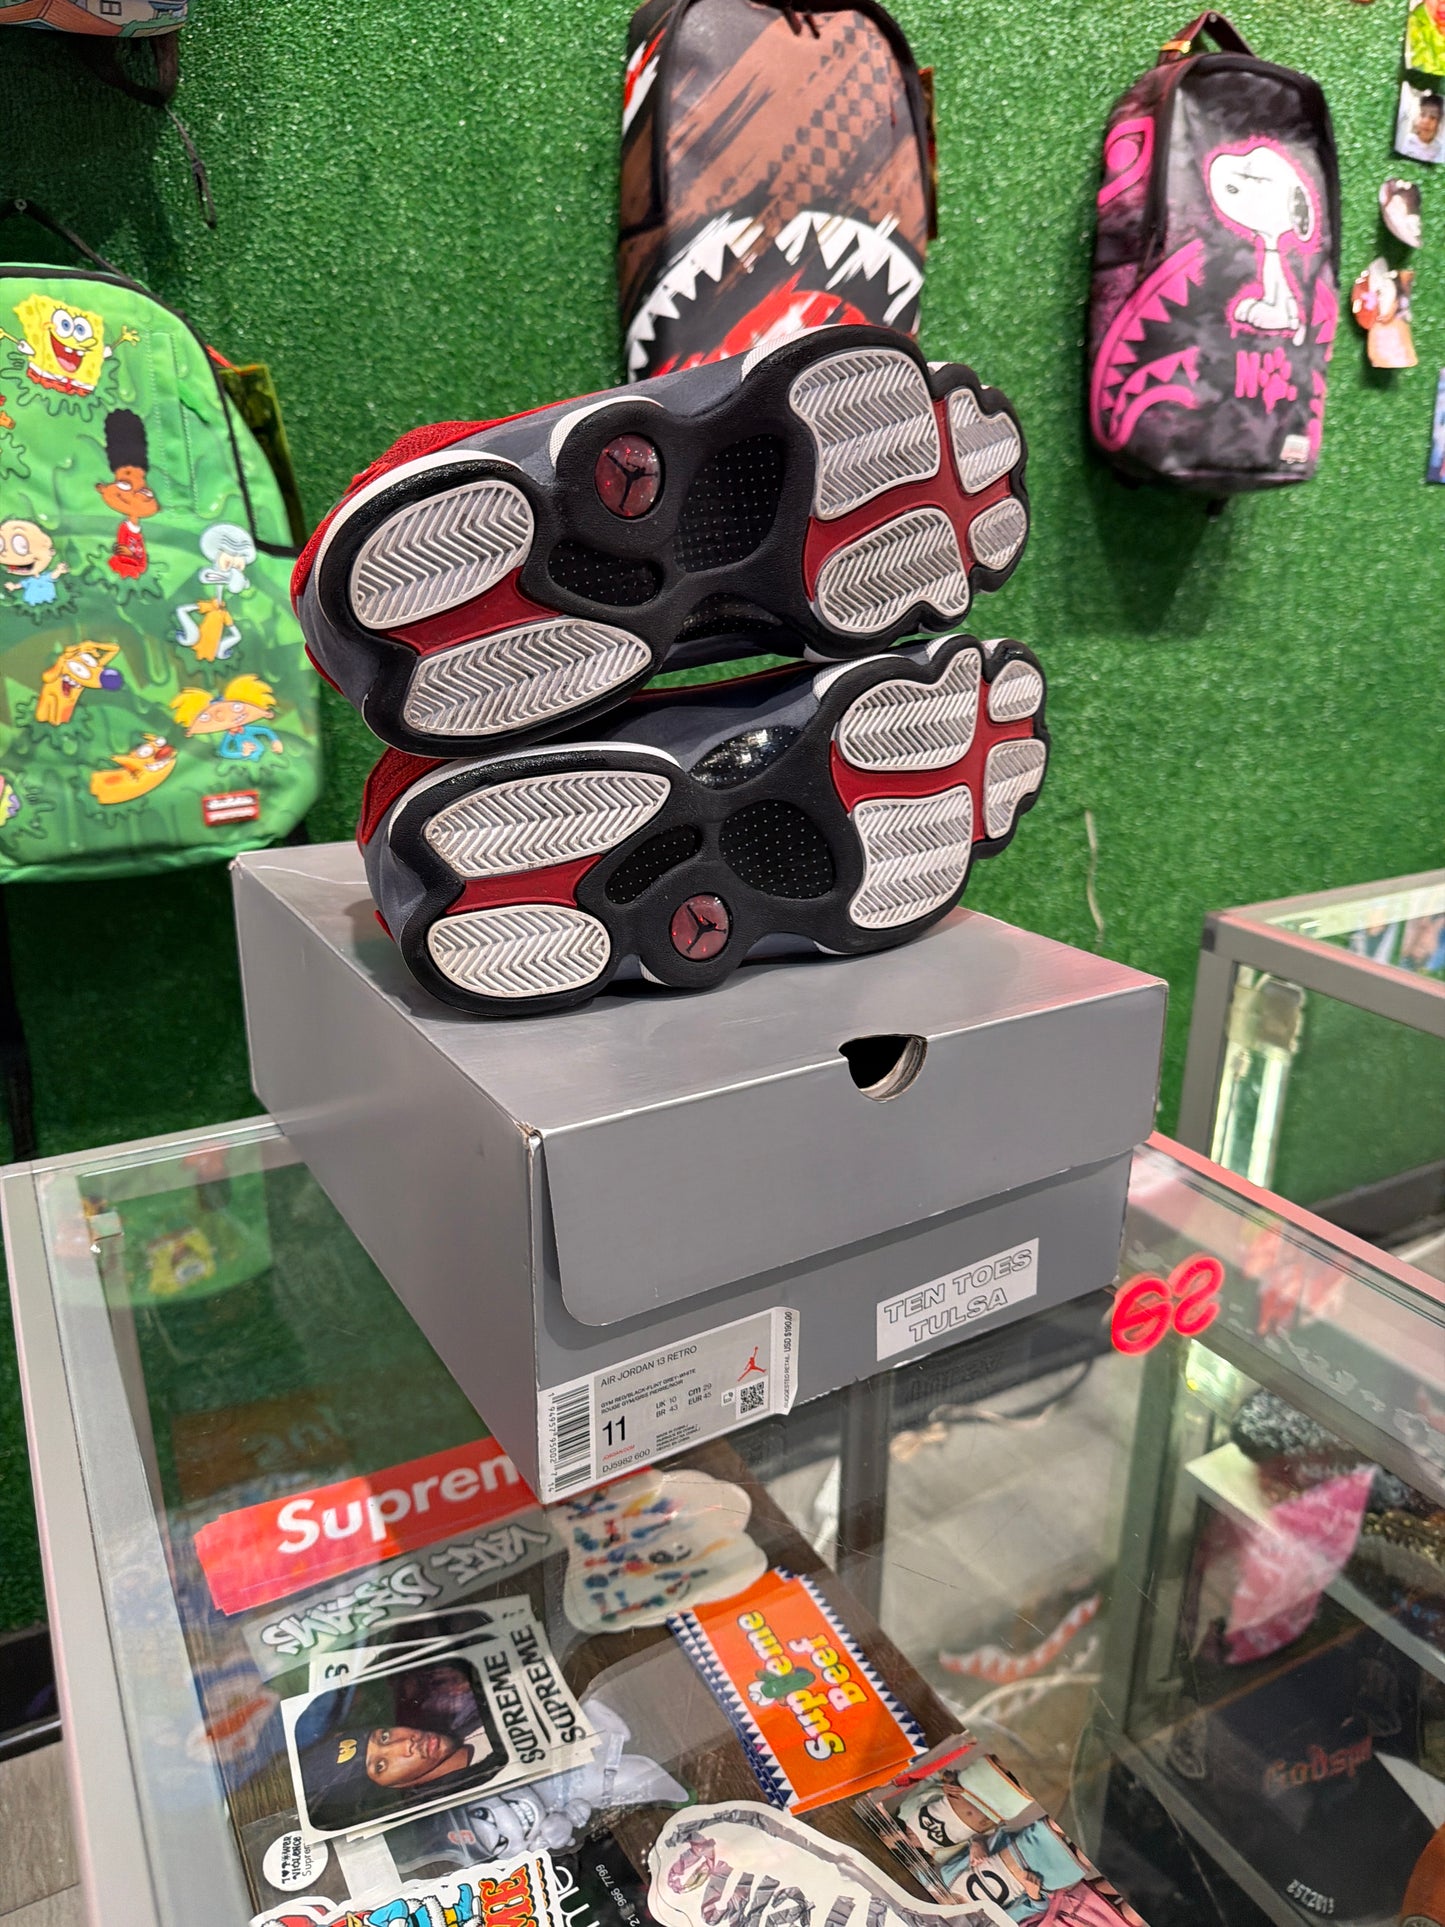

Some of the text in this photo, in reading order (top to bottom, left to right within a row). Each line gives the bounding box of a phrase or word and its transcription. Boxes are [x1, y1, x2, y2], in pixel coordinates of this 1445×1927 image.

[883, 1249, 1032, 1324] TEN TOES
[784, 1311, 793, 1337] $190.00
[909, 1287, 1008, 1342] TULSA
[784, 1338, 792, 1353] USD
[601, 1345, 698, 1388] AIR JORDAN 13 RETRO
[600, 1399, 614, 1408] GYM
[656, 1383, 712, 1410] UK 10 cm 29
[656, 1391, 712, 1418] BR 43 EUR 45
[602, 1415, 625, 1447] 11
[602, 1448, 650, 1473] DJ5982 600
[510, 1624, 587, 1744] SUPREME
[484, 1650, 546, 1764] SUPREME
[594, 1863, 616, 1888] 7799
[610, 1887, 628, 1907] 966
